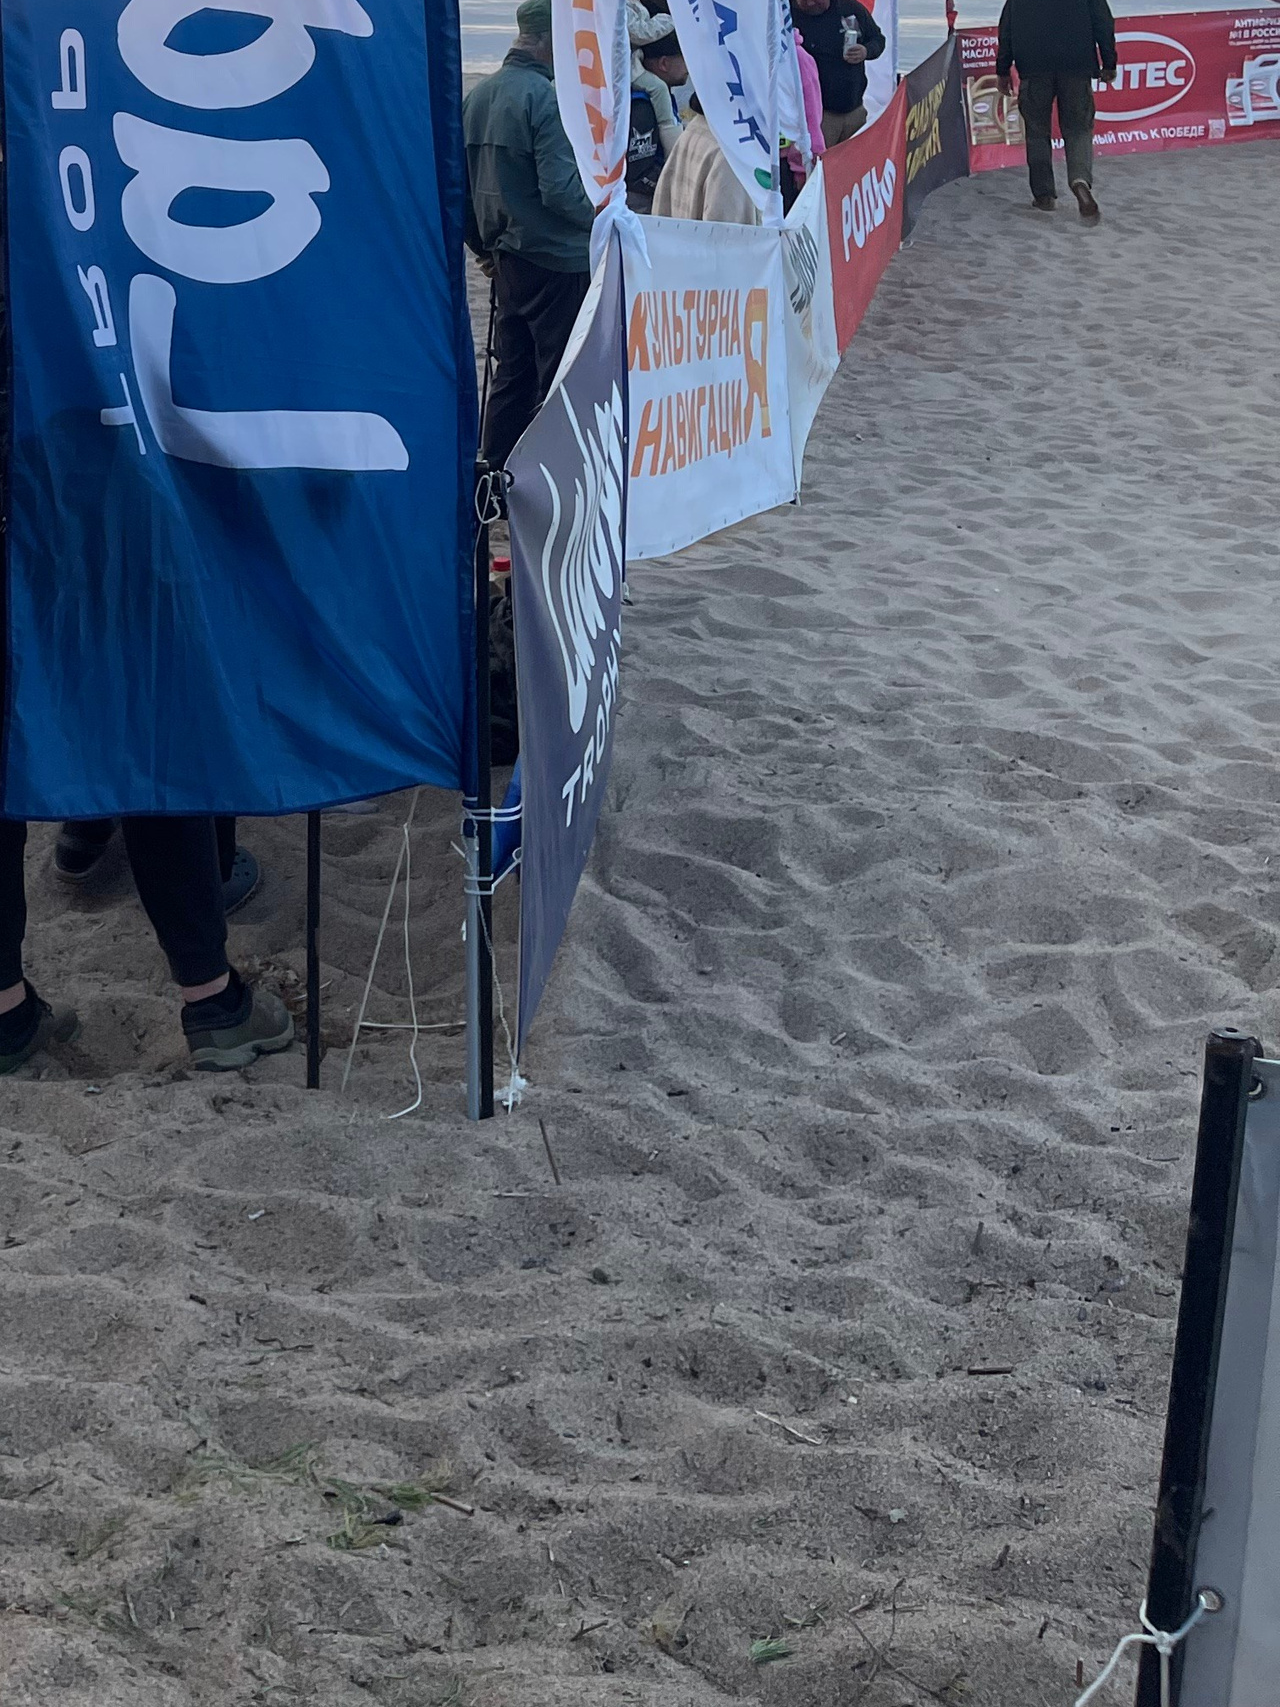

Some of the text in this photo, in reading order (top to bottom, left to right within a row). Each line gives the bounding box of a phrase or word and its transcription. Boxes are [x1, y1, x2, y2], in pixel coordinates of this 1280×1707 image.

[962, 48, 996, 59] МАСЛА
[1091, 59, 1186, 93] INTEC
[1118, 128, 1148, 143] ПУТЬ
[1150, 128, 1161, 139] К
[1161, 125, 1205, 139] ПОБЕДЕ
